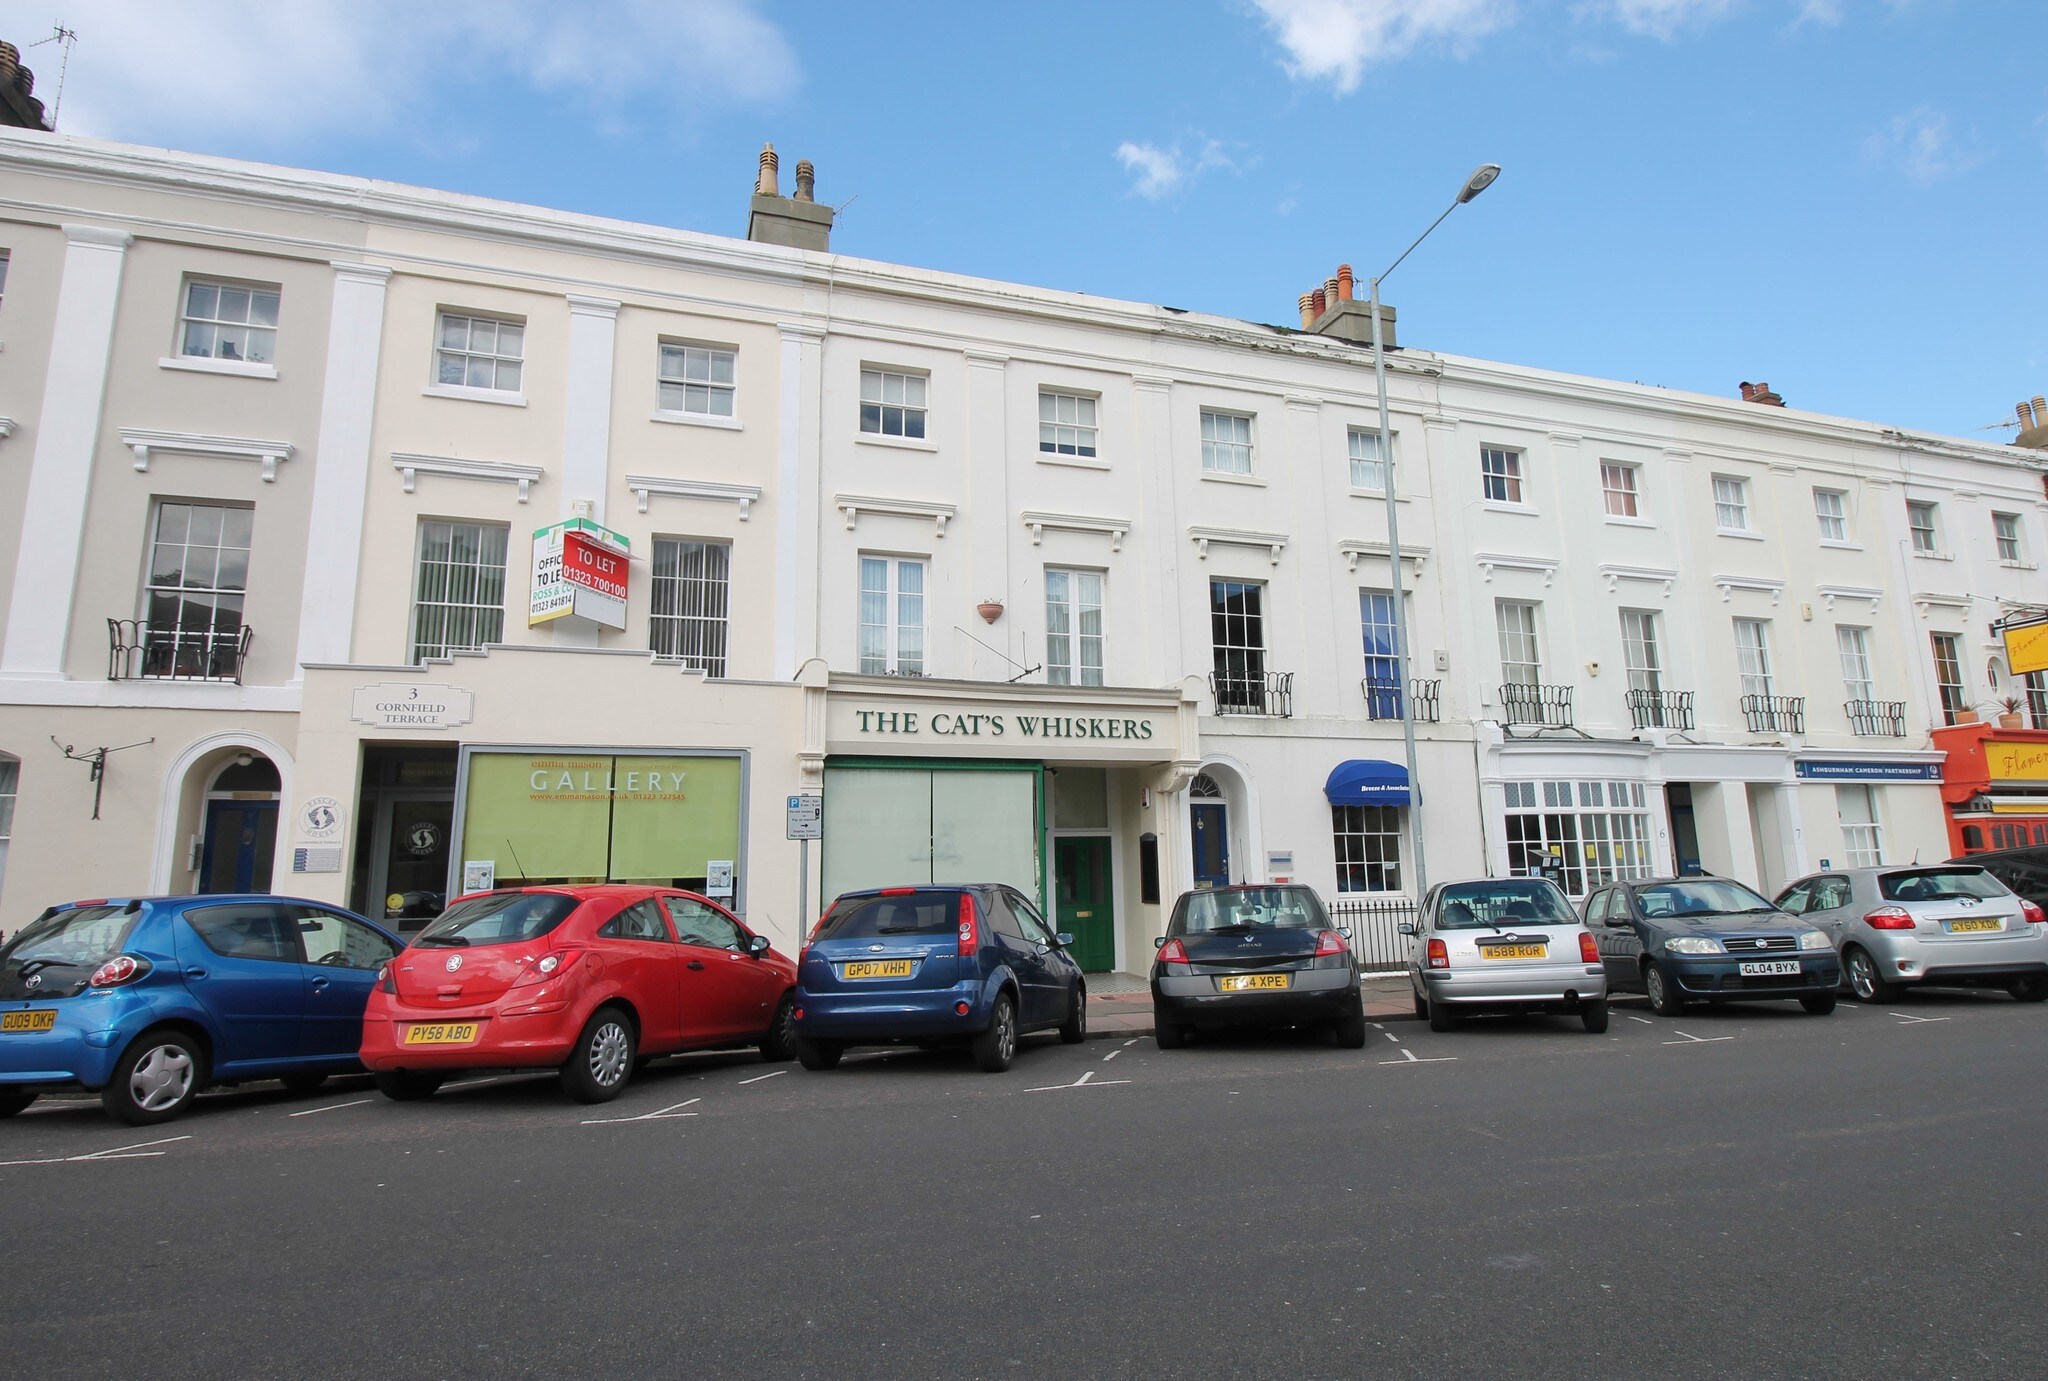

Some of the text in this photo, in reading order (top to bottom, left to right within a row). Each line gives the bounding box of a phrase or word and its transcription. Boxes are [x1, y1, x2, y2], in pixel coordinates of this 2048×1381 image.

[538, 554, 562, 570] OFFIC
[577, 547, 616, 575] TO LET
[537, 569, 562, 587] TO LE
[563, 565, 626, 598] 01323 700100
[532, 588, 552, 602] ROSS
[553, 585, 560, 595] &
[531, 594, 572, 613] 01323 841814
[408, 687, 418, 700] 3
[375, 702, 446, 713] CORNFIELD
[384, 714, 439, 724] TERRACE
[856, 710, 1153, 740] THE CAT'S WHISKERS
[531, 761, 564, 769] emma
[568, 760, 602, 769] mason
[530, 770, 686, 791] GALLERY
[791, 798, 798, 808] P
[1659, 828, 1666, 839] 6
[1796, 828, 1801, 839] 7
[1980, 919, 2001, 929] XDK
[1486, 946, 1516, 957] W588
[848, 962, 906, 976] GP07 VHH
[1744, 962, 1796, 974] GL04 BYX
[1226, 975, 1283, 989] F4 XPE
[3, 1012, 56, 1029] GU09 OKH
[411, 1025, 472, 1041] PY58 ABO
